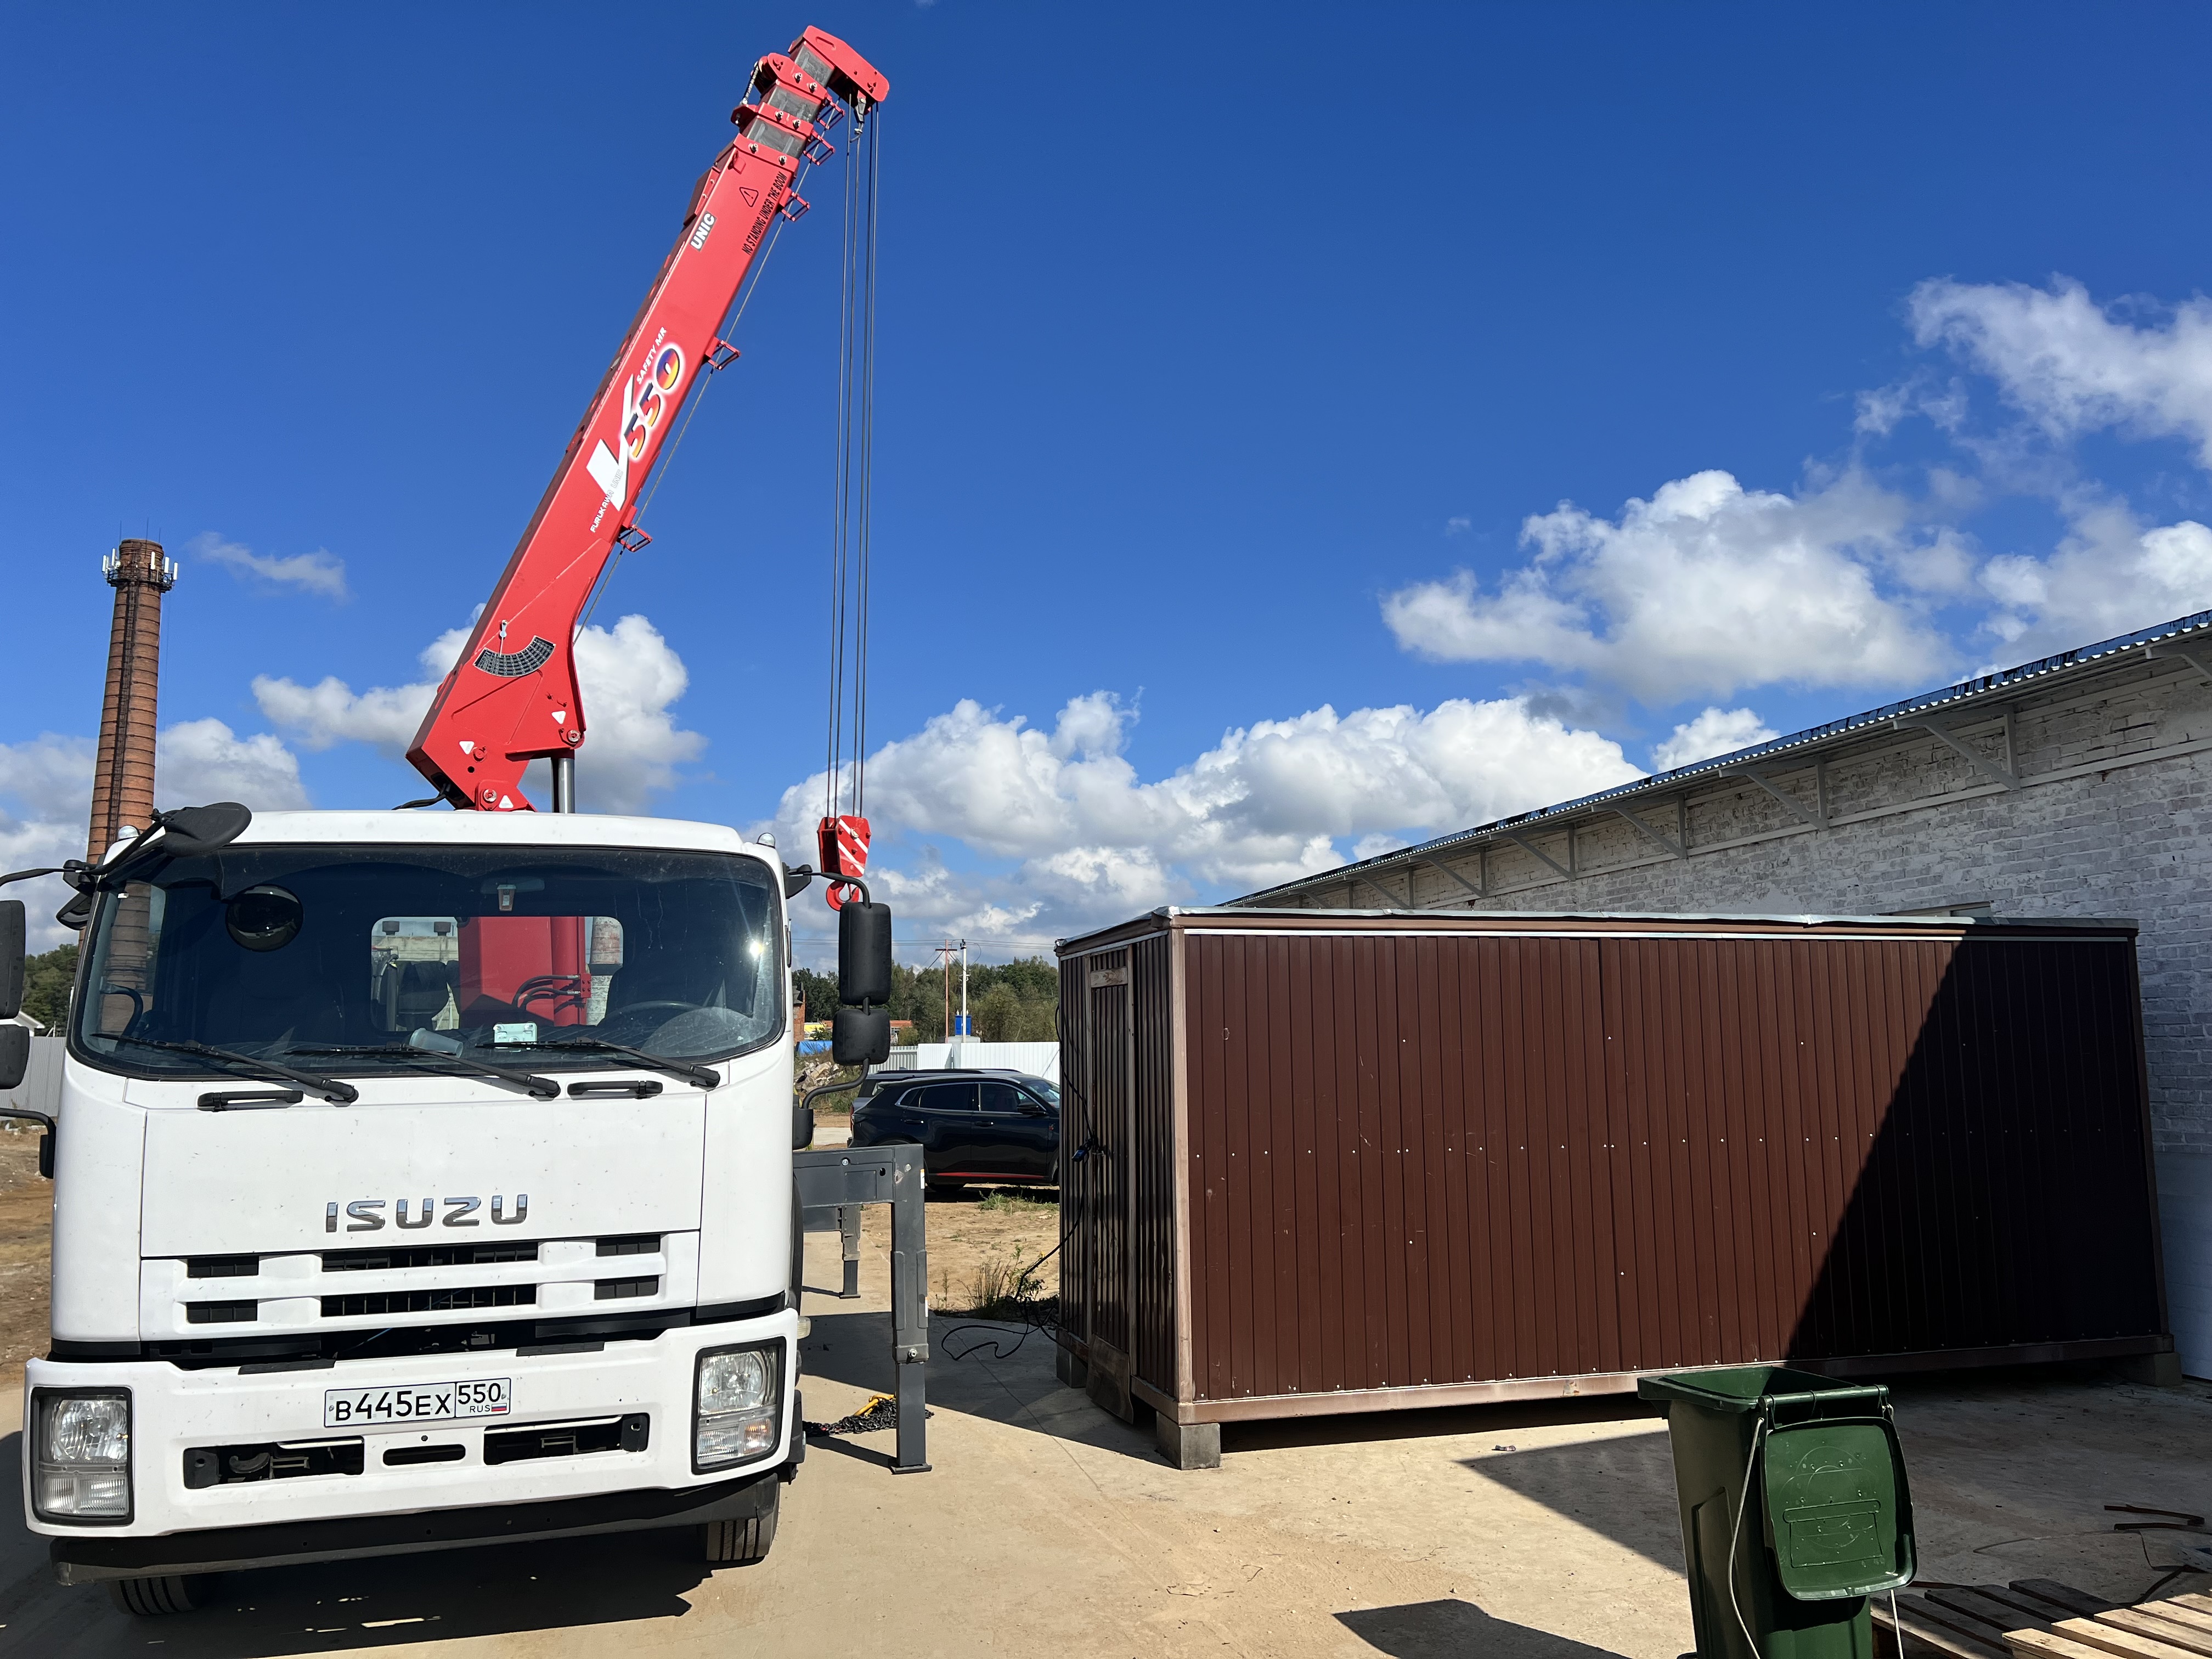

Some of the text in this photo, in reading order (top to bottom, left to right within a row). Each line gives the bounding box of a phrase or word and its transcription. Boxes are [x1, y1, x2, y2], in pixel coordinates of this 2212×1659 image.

[690, 213, 714, 249] UNIC
[742, 171, 787, 256] NO STANDING UNDER THE BOOM
[636, 345, 657, 385] SAFETY
[590, 469, 623, 533] FURUKAWA UNIC
[326, 1194, 528, 1233] ISUZU
[458, 1383, 501, 1405] 550
[470, 1404, 491, 1413] RUS
